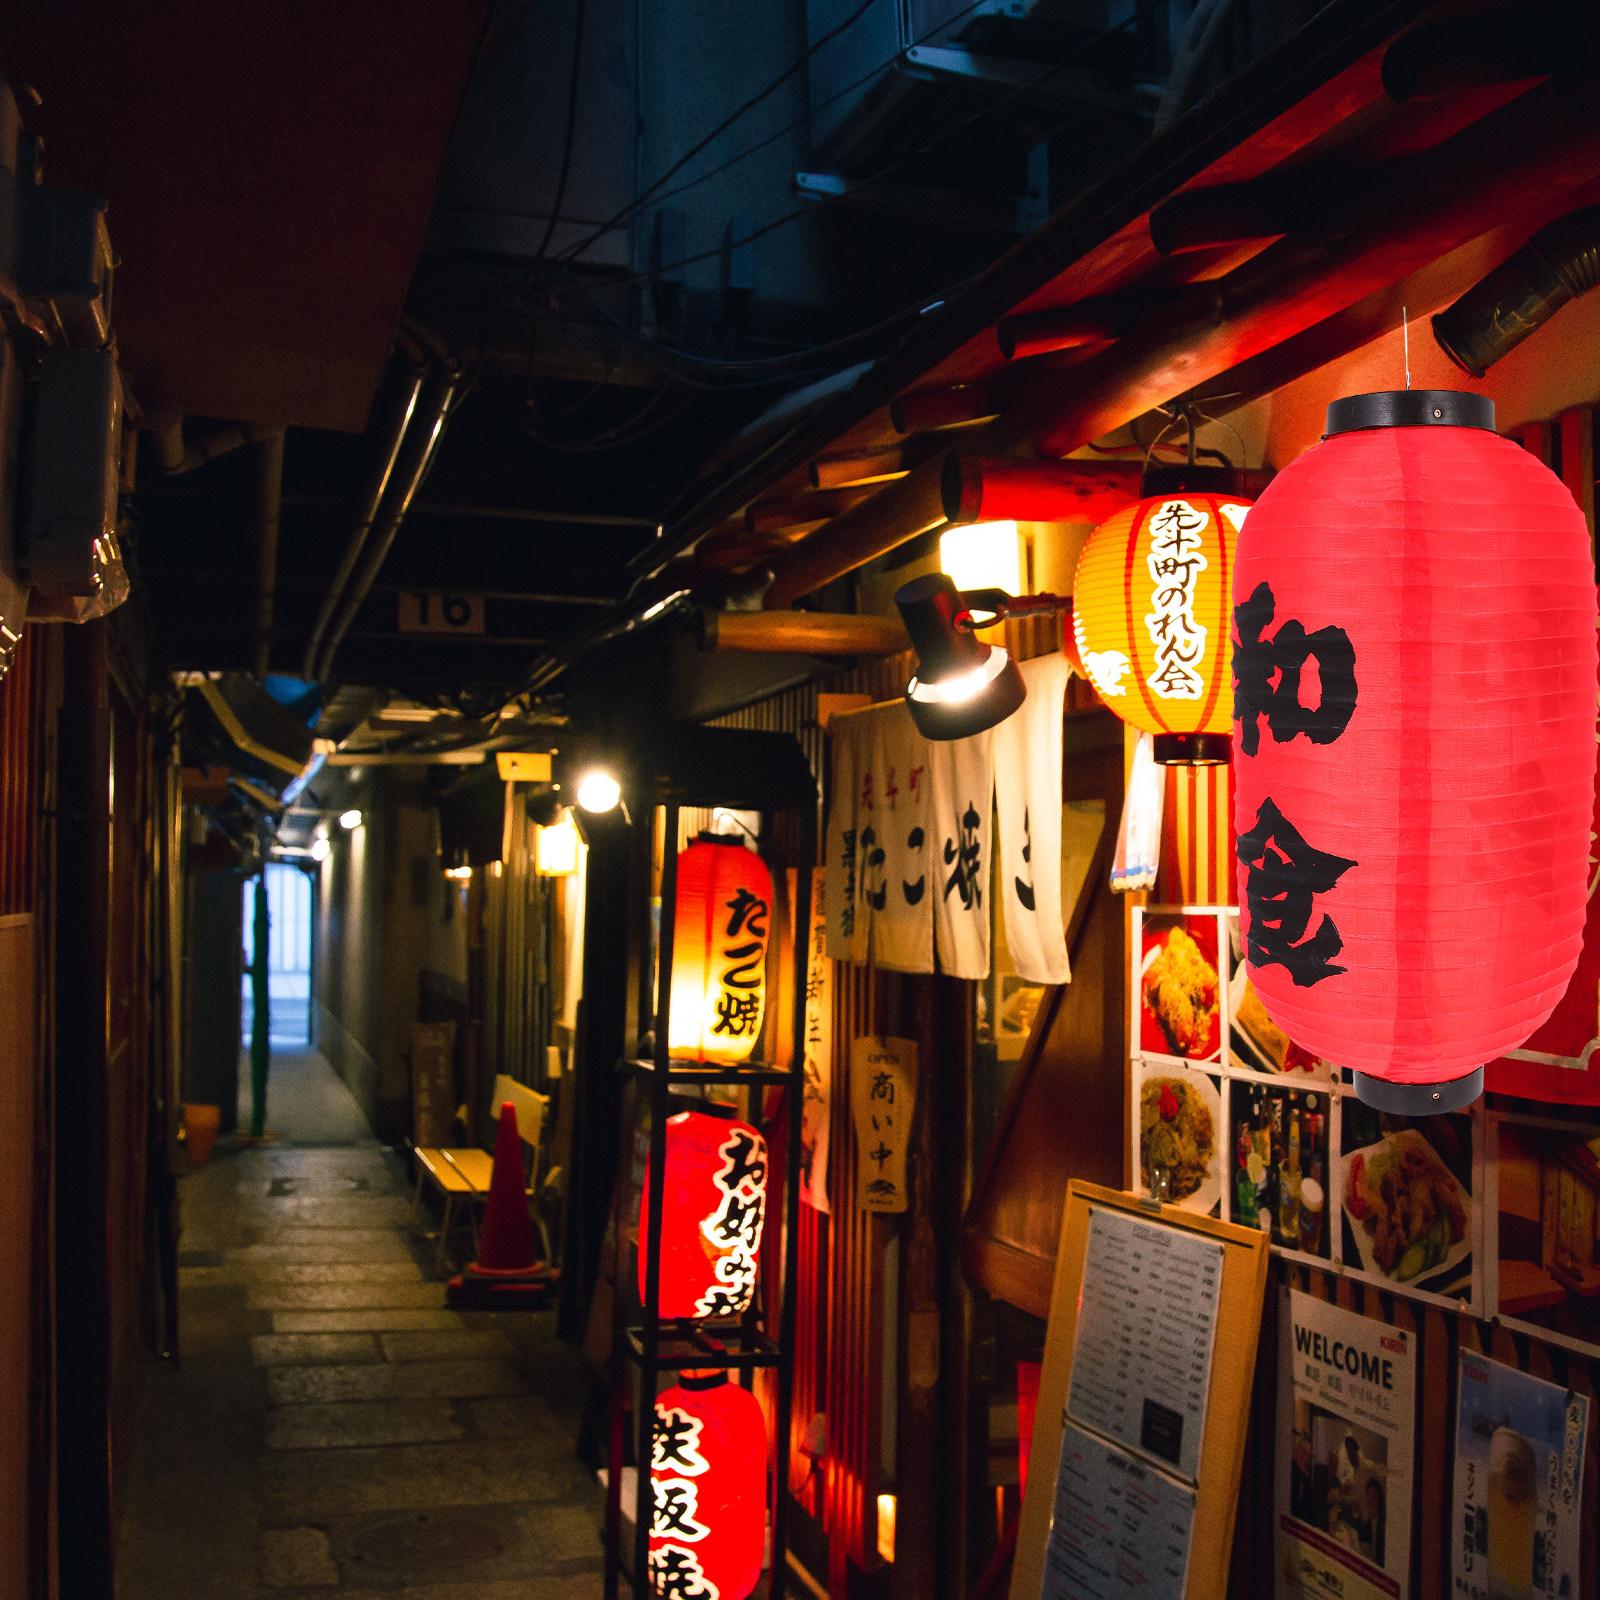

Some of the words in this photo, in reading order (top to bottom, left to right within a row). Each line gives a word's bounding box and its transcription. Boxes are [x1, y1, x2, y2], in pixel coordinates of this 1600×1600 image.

[412, 592, 472, 627] 16
[1153, 503, 1202, 694] 先斗町のれん会
[1232, 581, 1359, 988] 和食
[713, 887, 768, 1036] たこ焼
[867, 1053, 901, 1065] OPEN
[869, 1071, 896, 1170] 商い中
[1294, 1324, 1393, 1390] WELCOME
